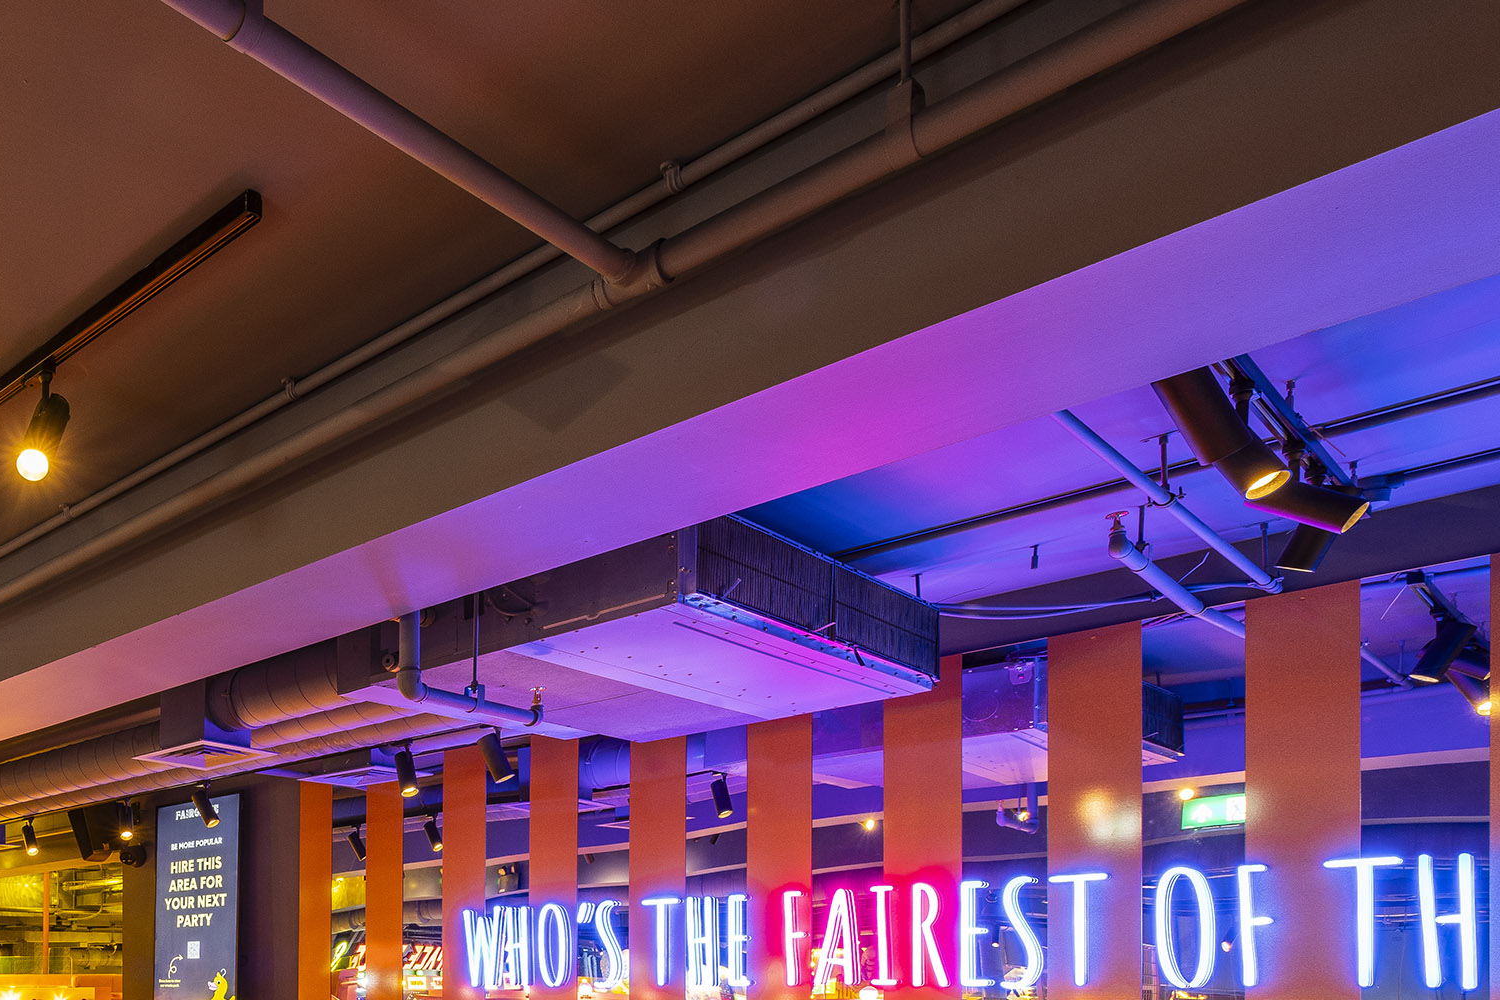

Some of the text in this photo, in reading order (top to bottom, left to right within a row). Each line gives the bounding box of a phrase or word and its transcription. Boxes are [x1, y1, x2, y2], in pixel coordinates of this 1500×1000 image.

[175, 804, 220, 820] FAIRGE
[171, 837, 223, 851] BE MORE POPULAR
[170, 856, 222, 874] HIRE THIS
[168, 875, 223, 892] AREA FOR
[164, 893, 227, 910] YOUR NEXT
[176, 913, 213, 928] PARTY
[462, 852, 1478, 990] WHO'S THE FAIREST OF TH
